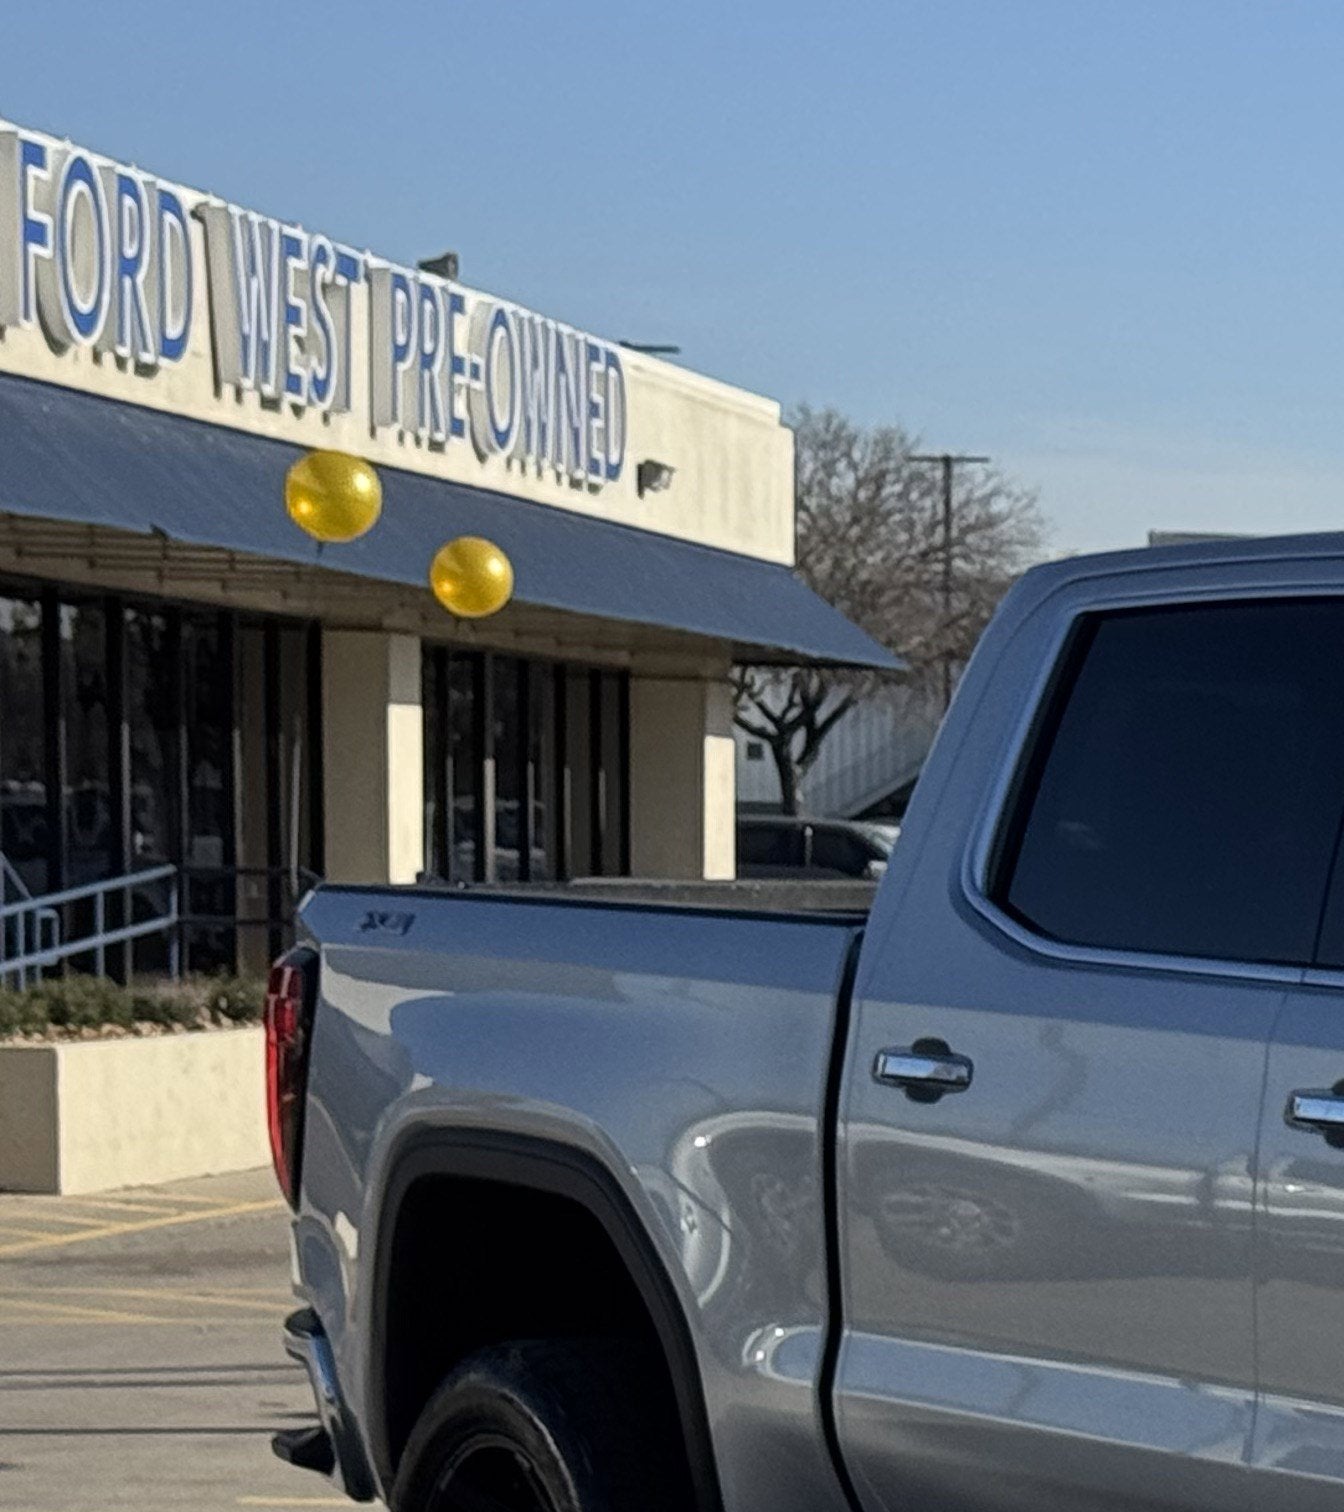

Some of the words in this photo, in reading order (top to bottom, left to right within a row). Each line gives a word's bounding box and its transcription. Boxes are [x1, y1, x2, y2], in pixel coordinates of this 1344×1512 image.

[18, 136, 195, 365] FORD
[226, 204, 367, 412] WEST
[389, 271, 628, 484] PRE-OWNED
